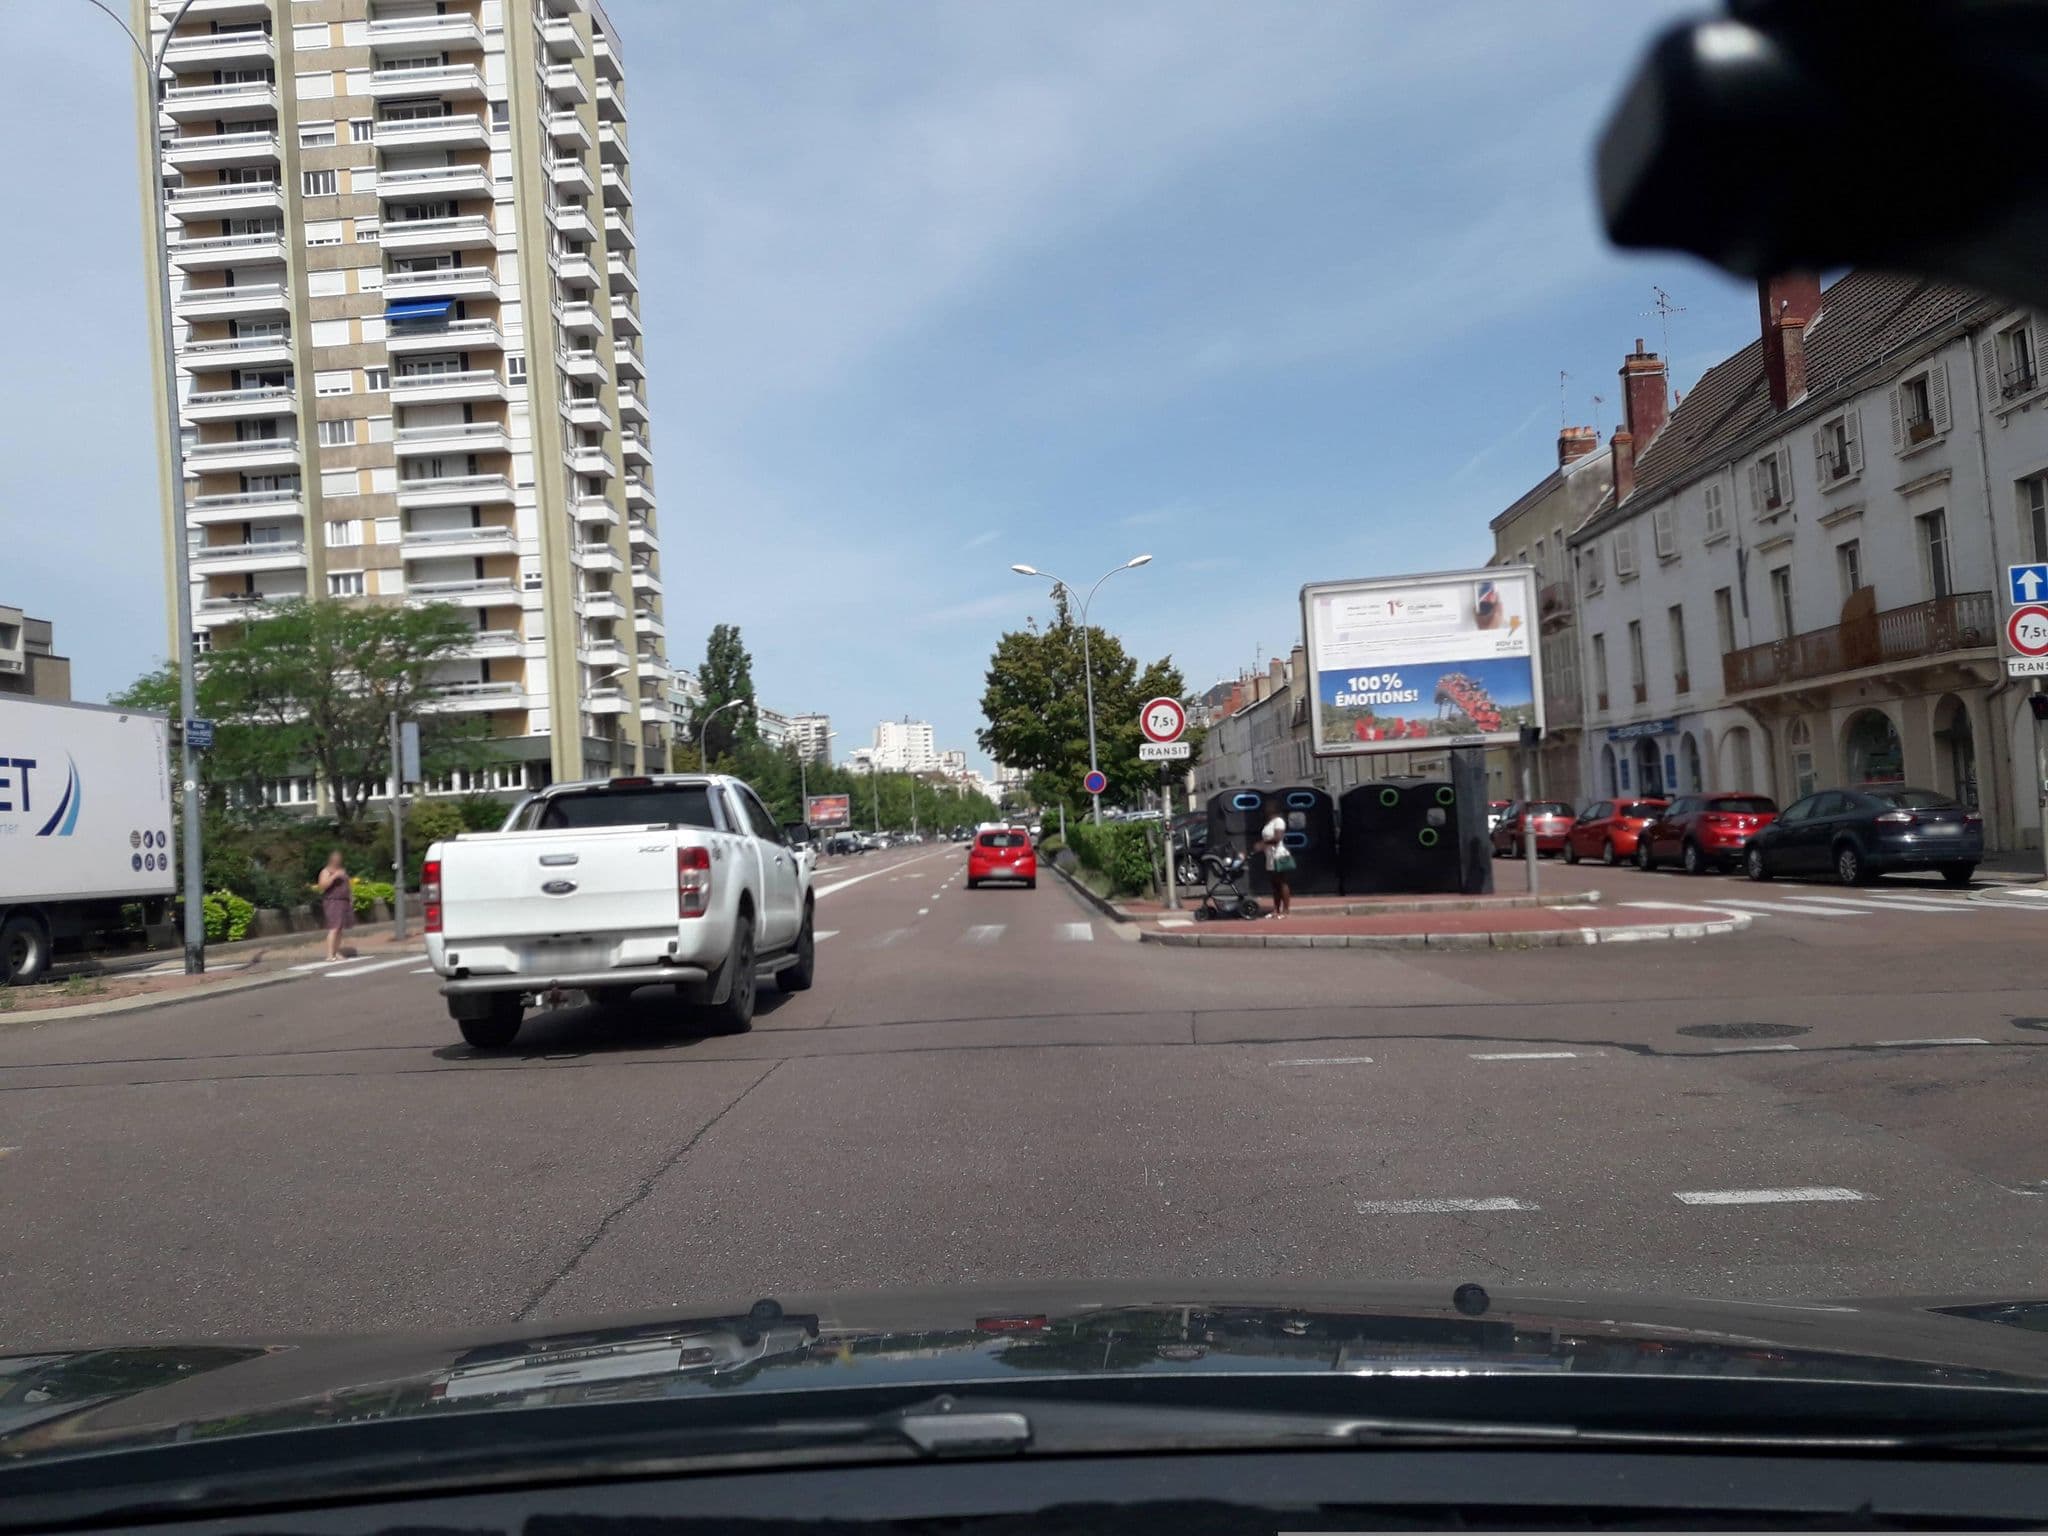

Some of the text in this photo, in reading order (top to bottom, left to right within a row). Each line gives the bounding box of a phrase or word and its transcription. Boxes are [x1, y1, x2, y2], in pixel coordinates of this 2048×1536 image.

[1347, 672, 1403, 692] 100%
[1335, 688, 1418, 707] ÉMOTIONS!
[1141, 746, 1188, 757] TRANSIT
